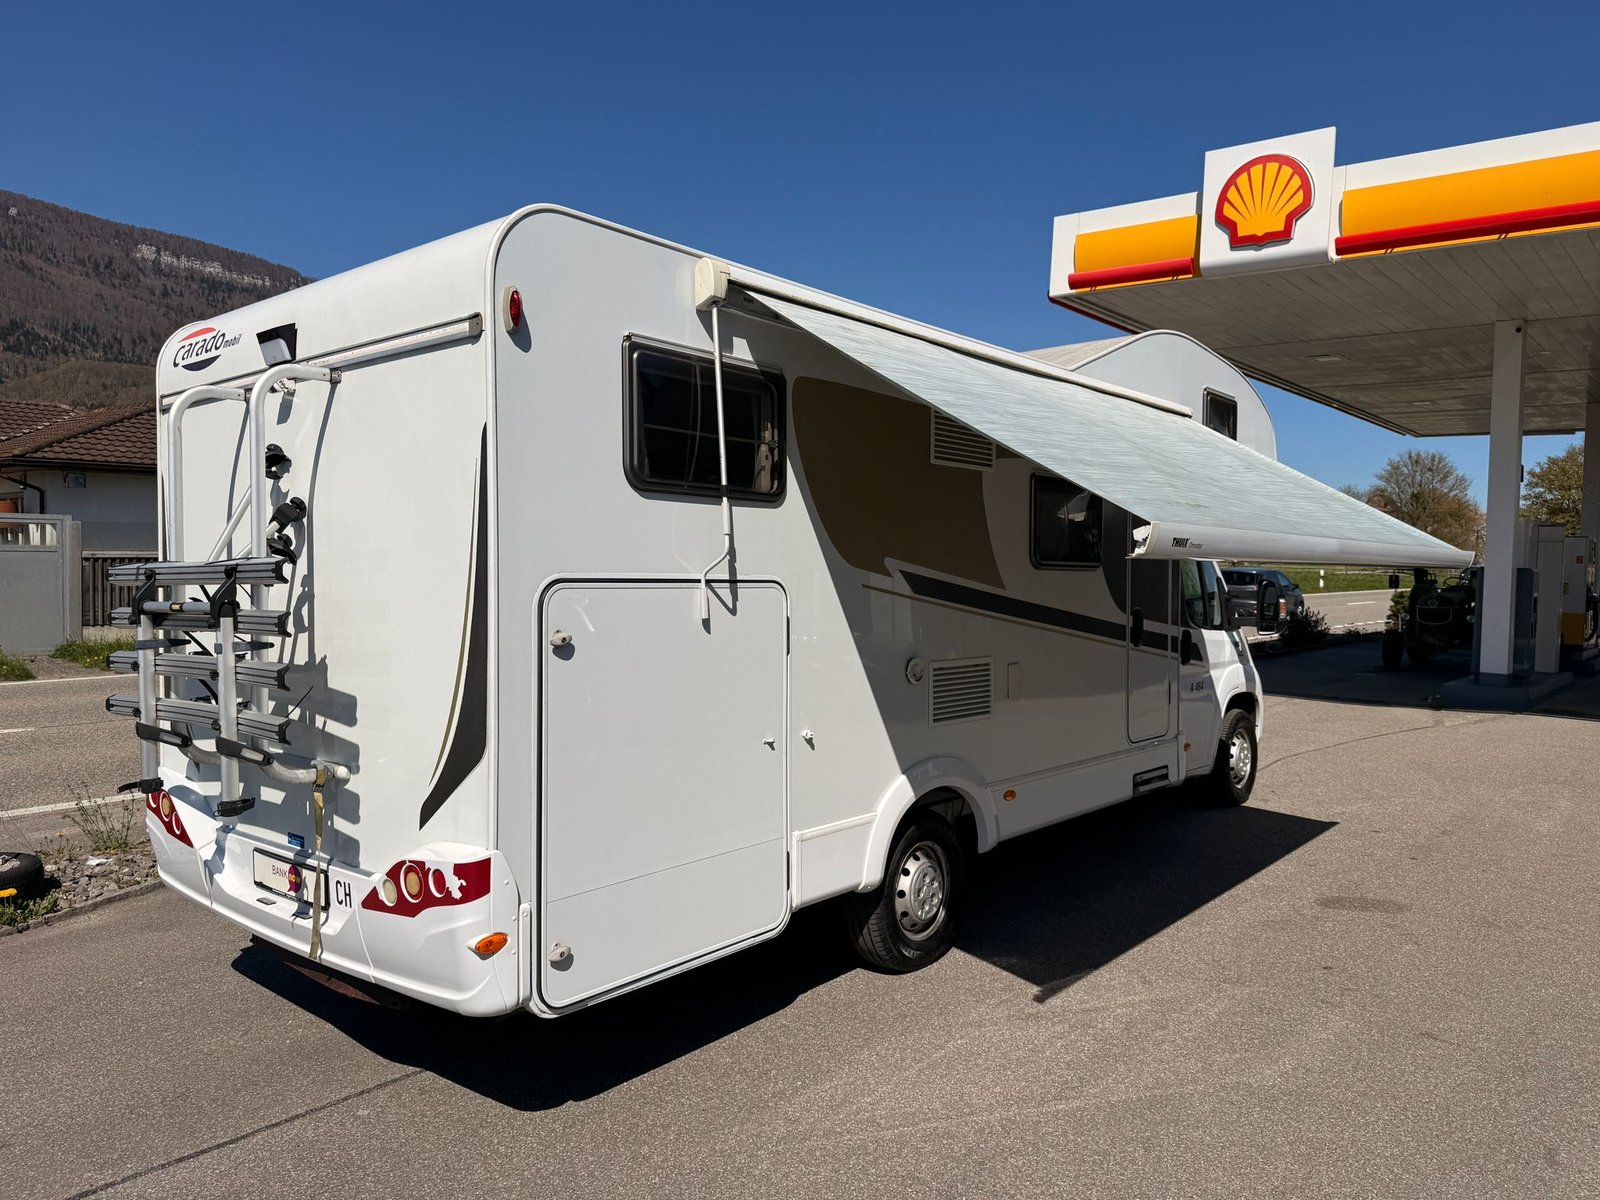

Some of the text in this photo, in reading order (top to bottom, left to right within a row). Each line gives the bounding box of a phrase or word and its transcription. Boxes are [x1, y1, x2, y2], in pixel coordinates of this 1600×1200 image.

[222, 333, 243, 349] mobil
[1171, 537, 1190, 549] THULE
[272, 864, 288, 879] BANK
[335, 880, 352, 908] CH
